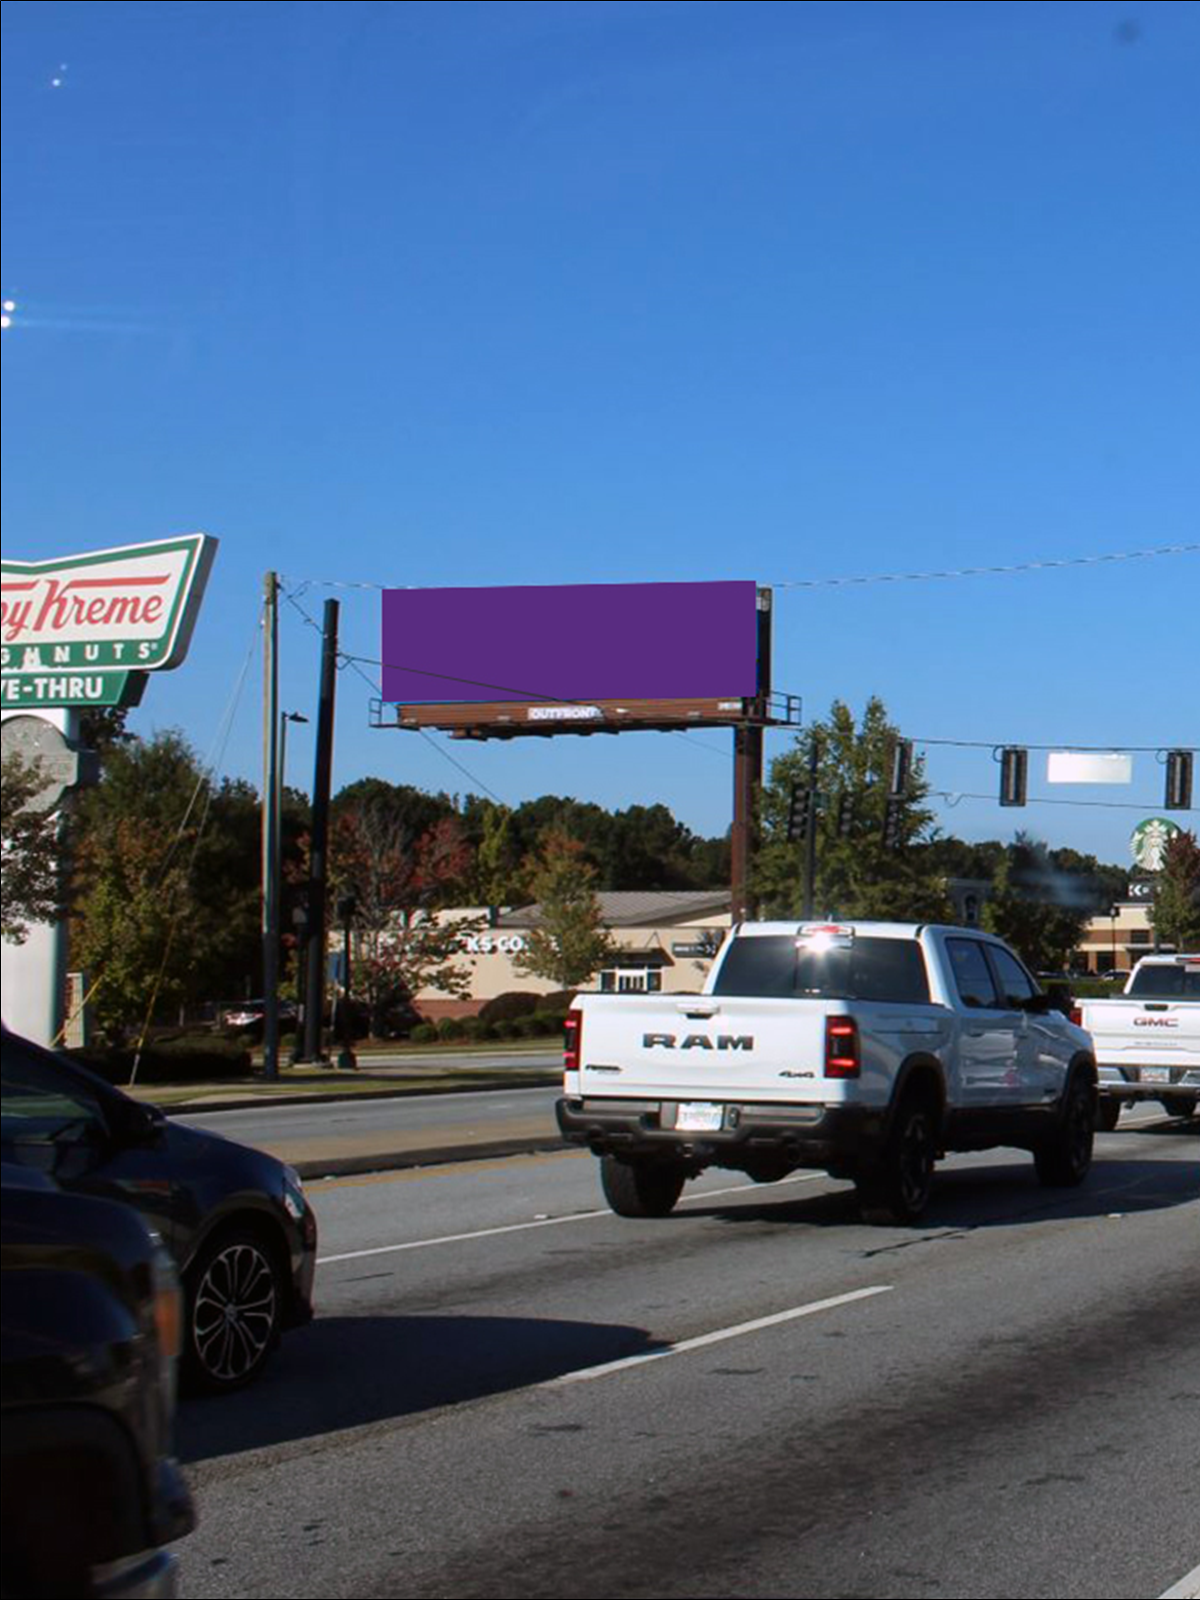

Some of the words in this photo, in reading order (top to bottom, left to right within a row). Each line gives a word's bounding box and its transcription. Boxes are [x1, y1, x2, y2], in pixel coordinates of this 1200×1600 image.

[32, 578, 164, 631] Kreme
[1133, 1017, 1180, 1028] GMC
[642, 1033, 754, 1051] RAM
